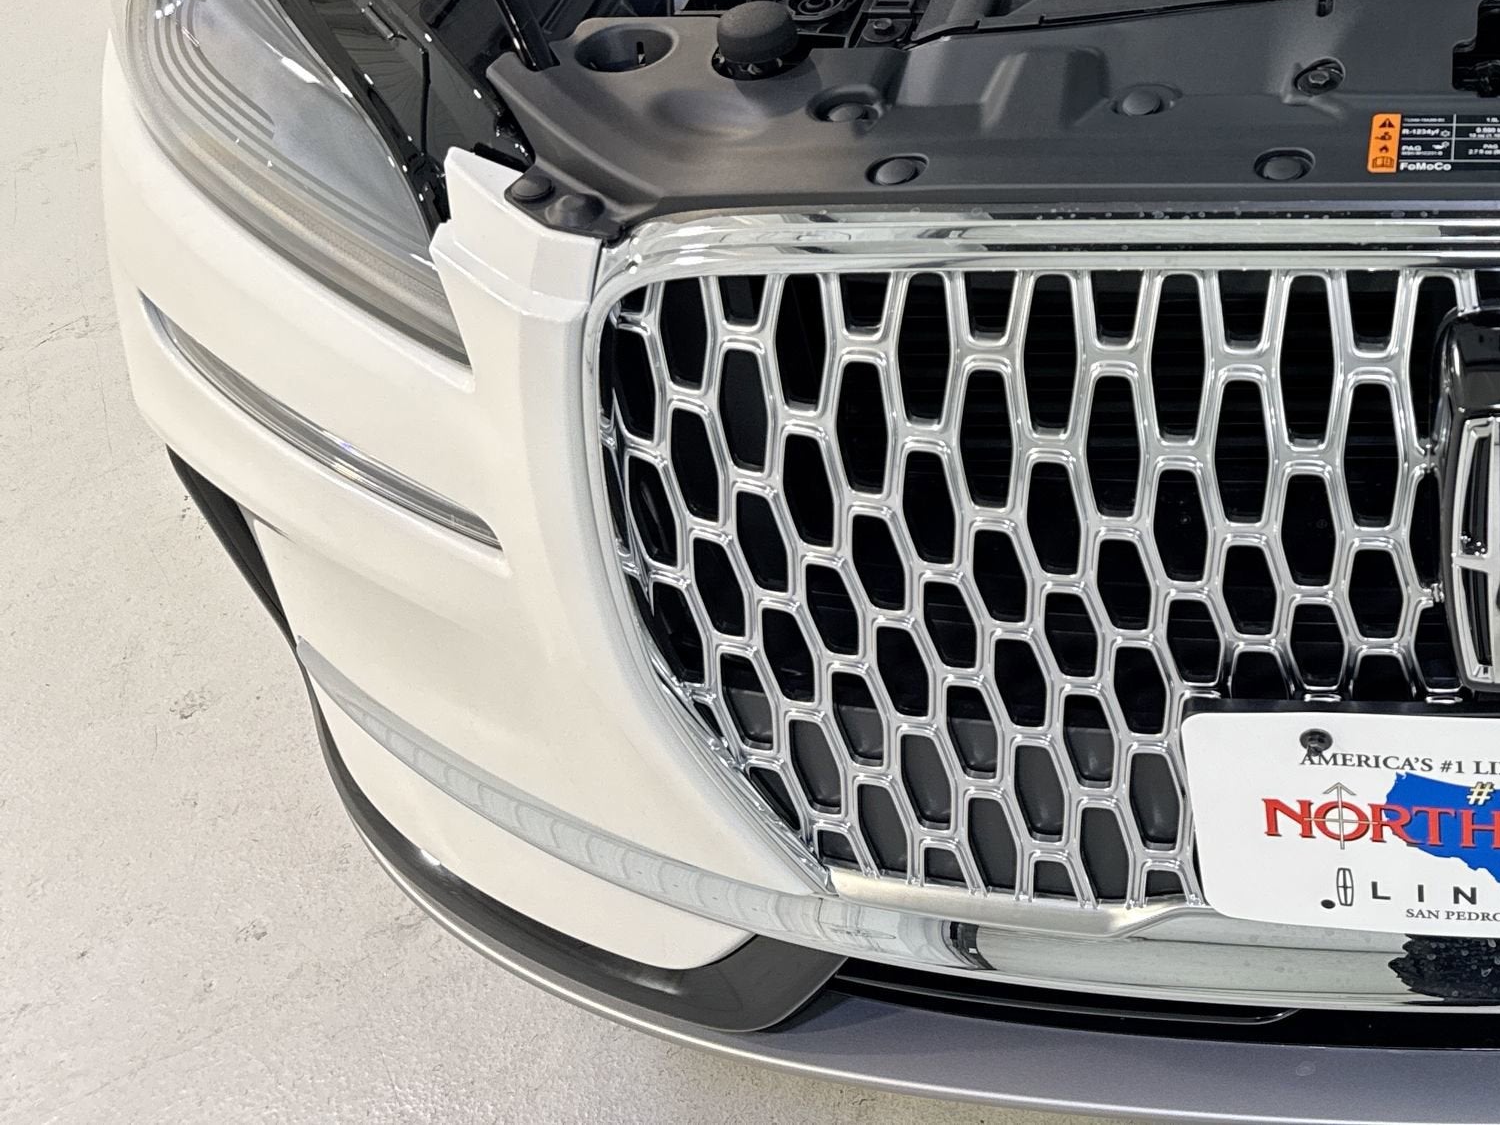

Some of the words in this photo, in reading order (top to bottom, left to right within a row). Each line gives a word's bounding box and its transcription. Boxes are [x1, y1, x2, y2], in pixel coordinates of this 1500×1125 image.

[1401, 128, 1440, 136] R-1234yf
[1399, 162, 1452, 171] FoMoCo
[1300, 748, 1434, 773] AMERICA'S
[1440, 760, 1465, 774] #1
[1405, 908, 1440, 921] SAN
